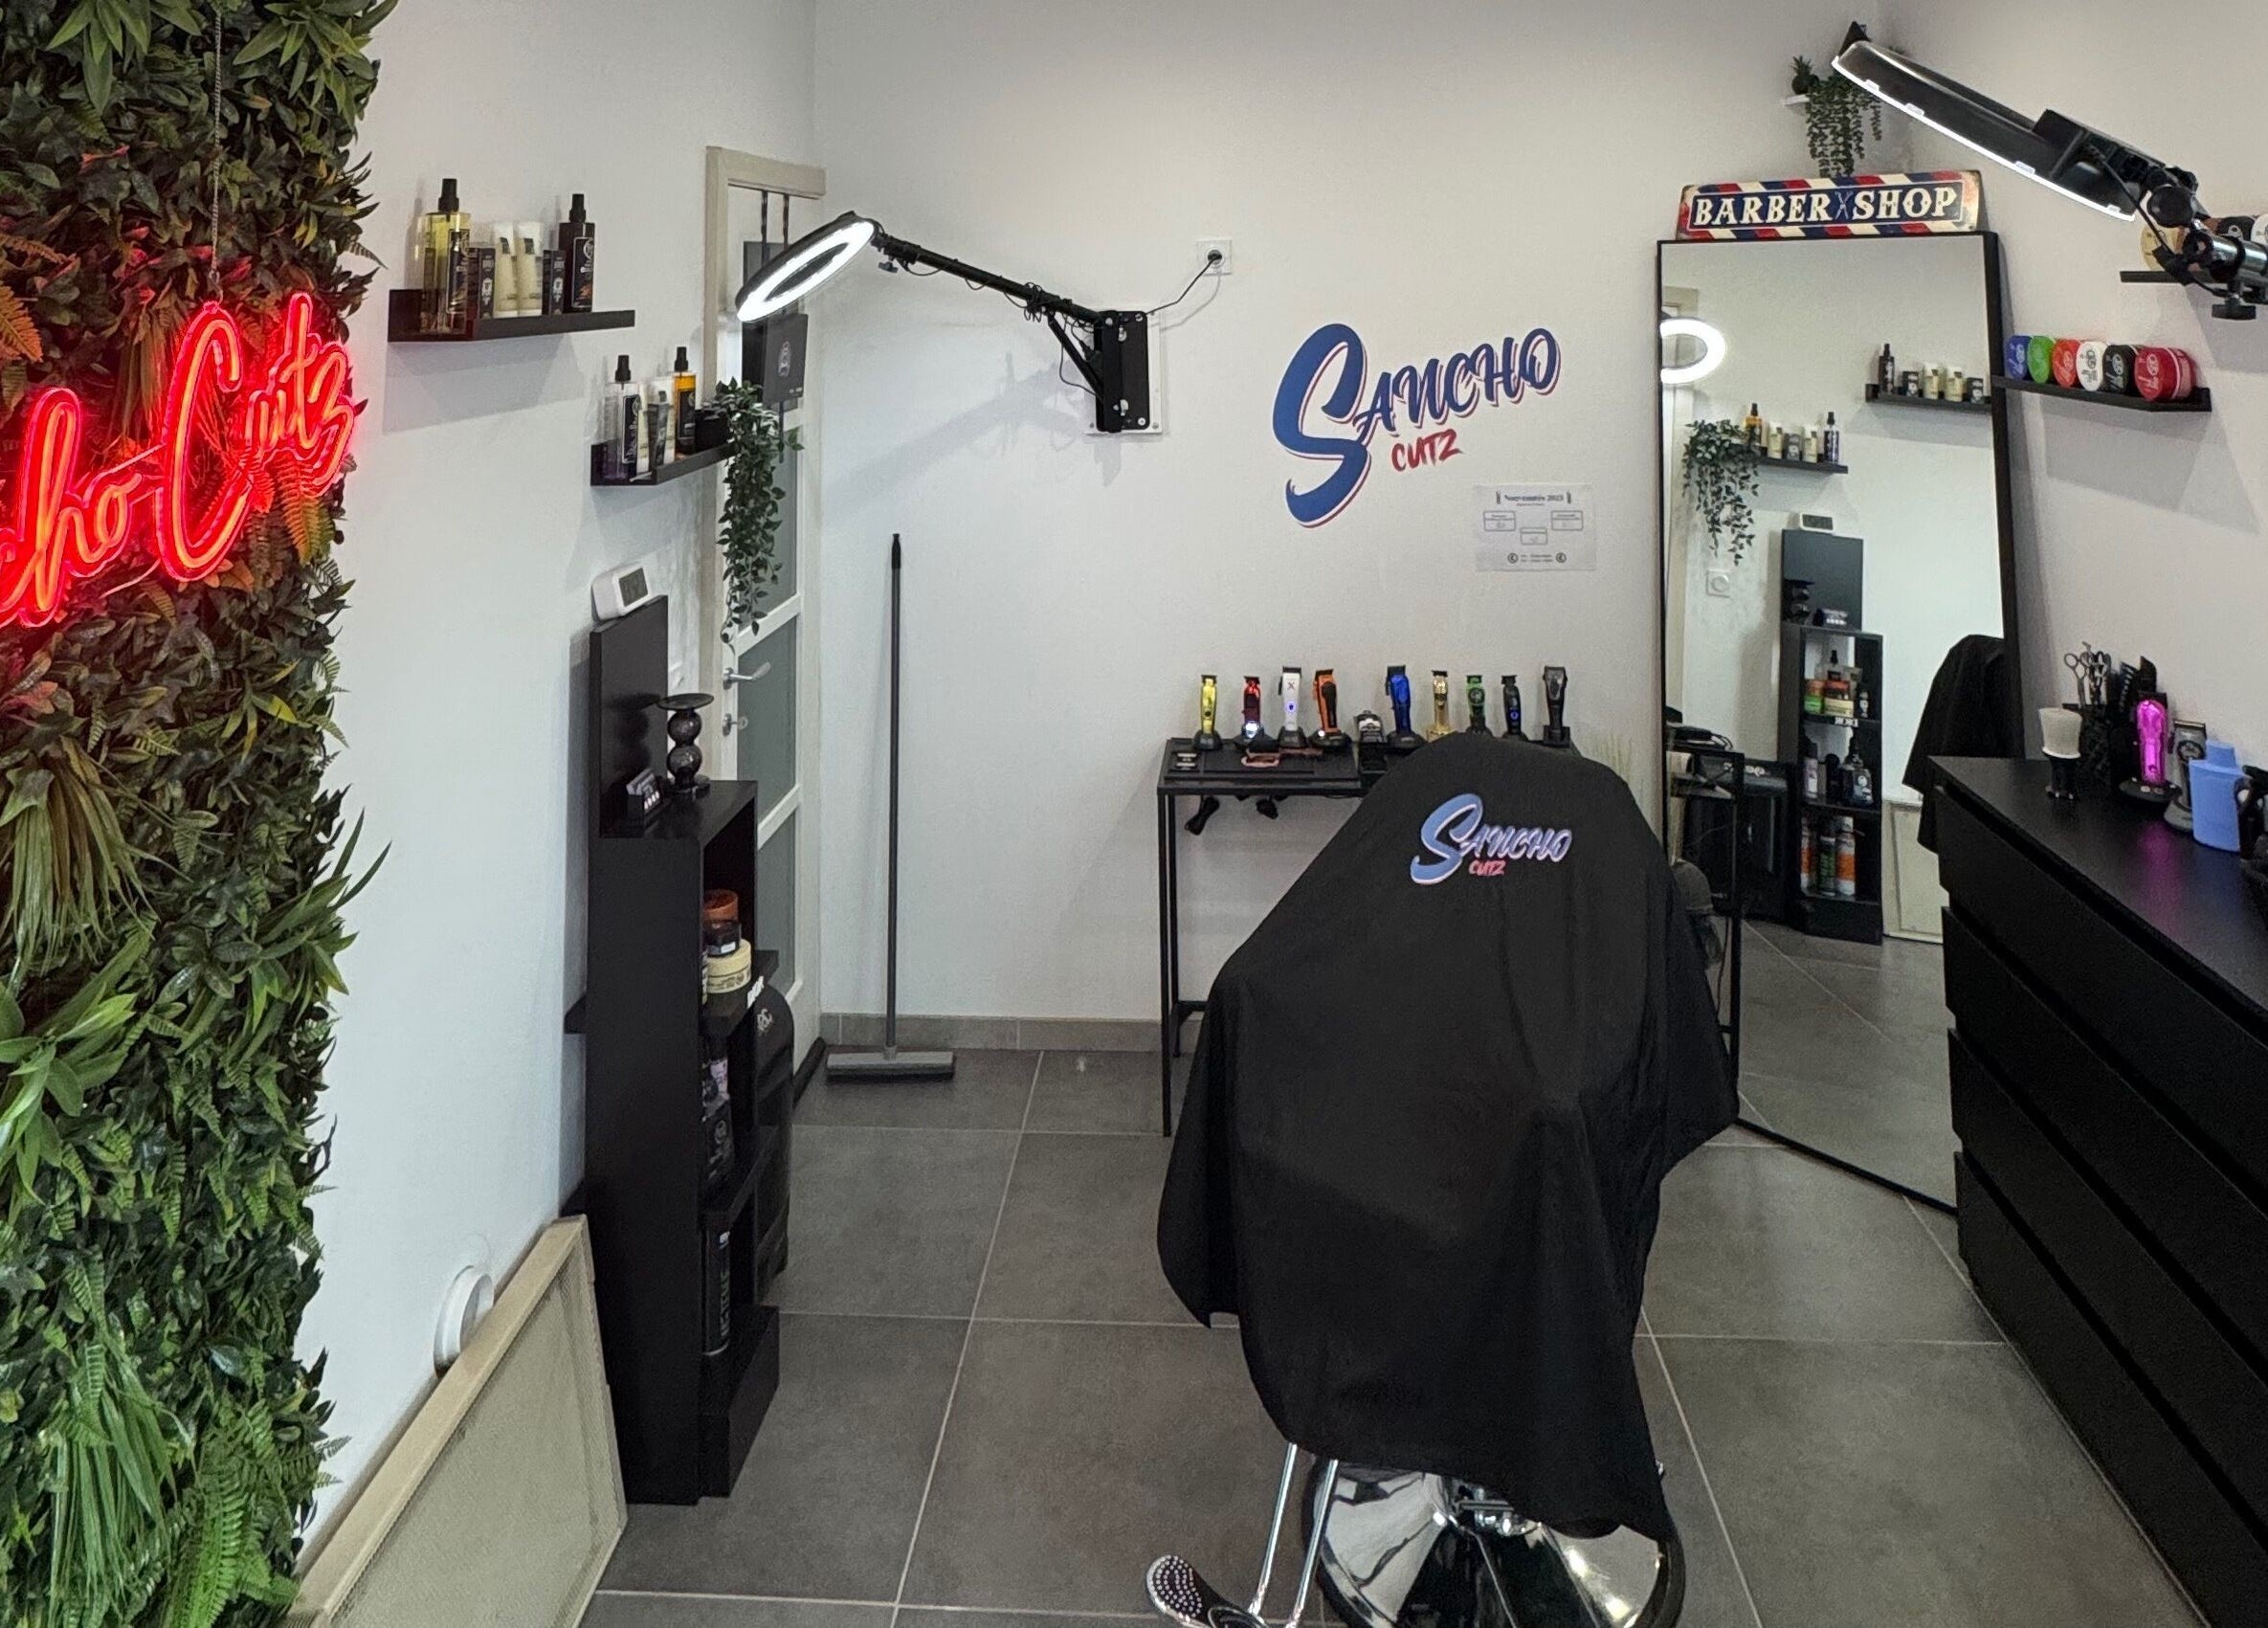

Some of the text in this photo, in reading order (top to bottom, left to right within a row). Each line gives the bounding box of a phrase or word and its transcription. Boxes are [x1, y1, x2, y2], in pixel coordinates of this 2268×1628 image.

[1693, 186, 1959, 226] BARBER SHOP
[1272, 323, 1562, 528] SANCHO
[1390, 428, 1463, 472] CUTZ
[0, 389, 145, 626] ho
[1410, 792, 1573, 885] SANCHO
[1468, 859, 1507, 877] CUTZ
